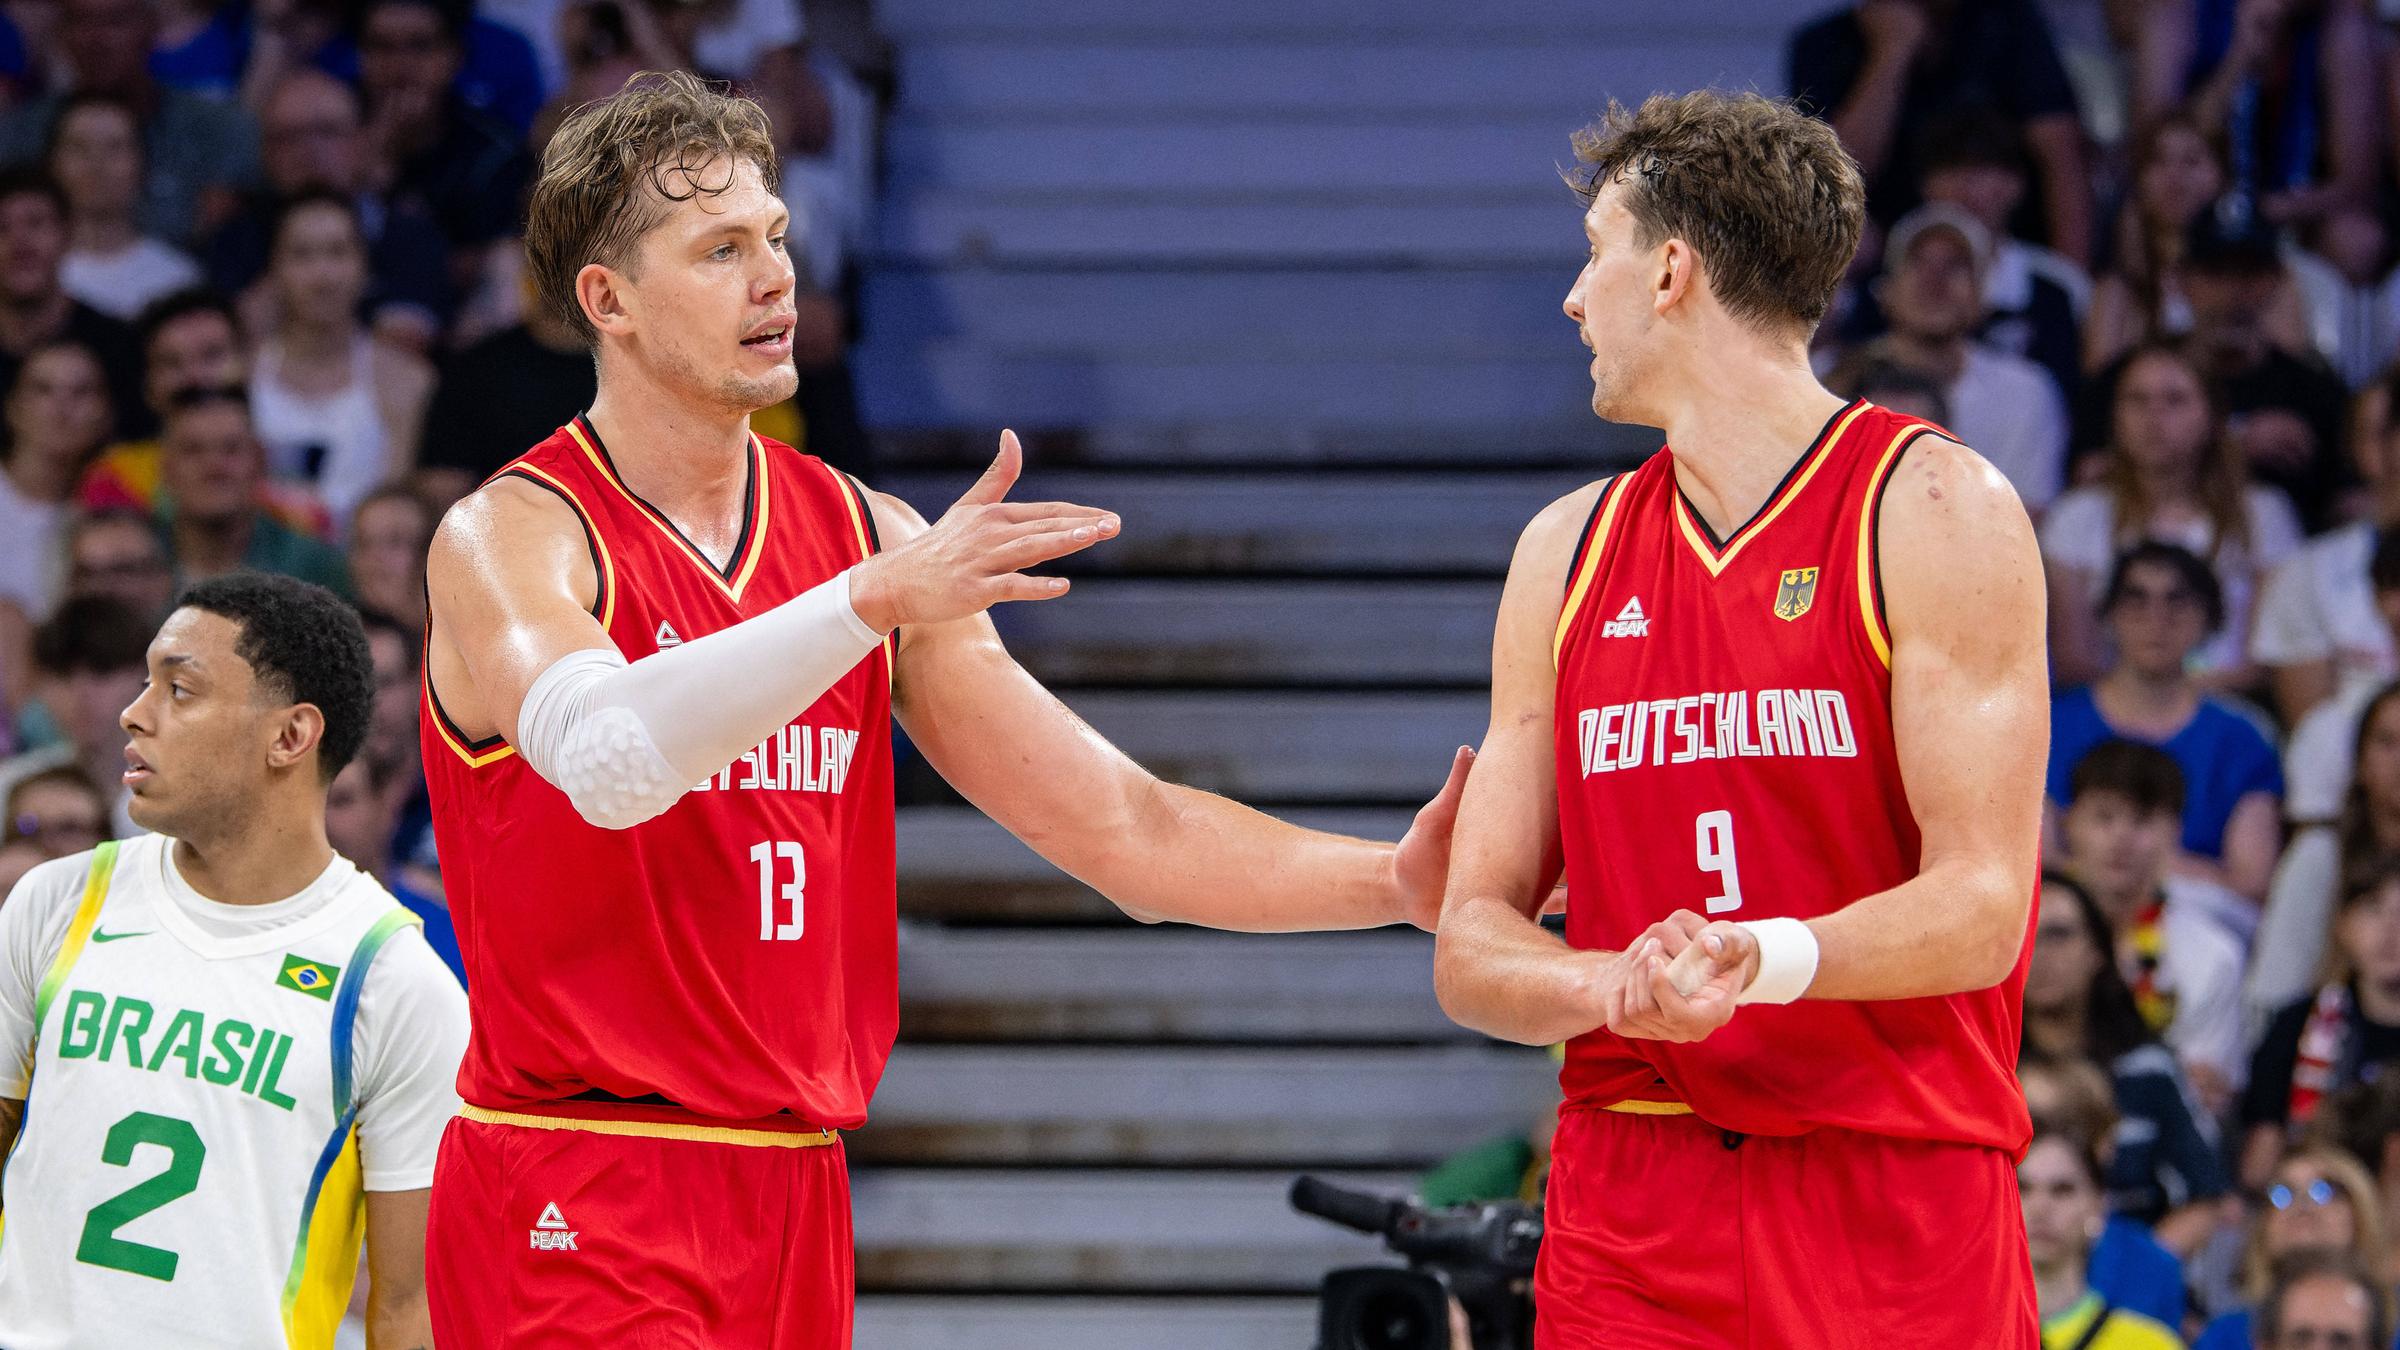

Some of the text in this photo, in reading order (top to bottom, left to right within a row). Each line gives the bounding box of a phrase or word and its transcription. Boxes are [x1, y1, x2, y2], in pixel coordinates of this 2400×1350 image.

[1601, 618, 1651, 638] PEAK
[691, 724, 860, 795] SCHLAN
[1578, 689, 1858, 780] DEUTSCHLAND
[750, 840, 806, 941] 13
[1695, 810, 1742, 914] 9
[59, 990, 299, 1112] BRASIL
[76, 1111, 206, 1281] 2
[529, 1229, 579, 1251] PEAK
